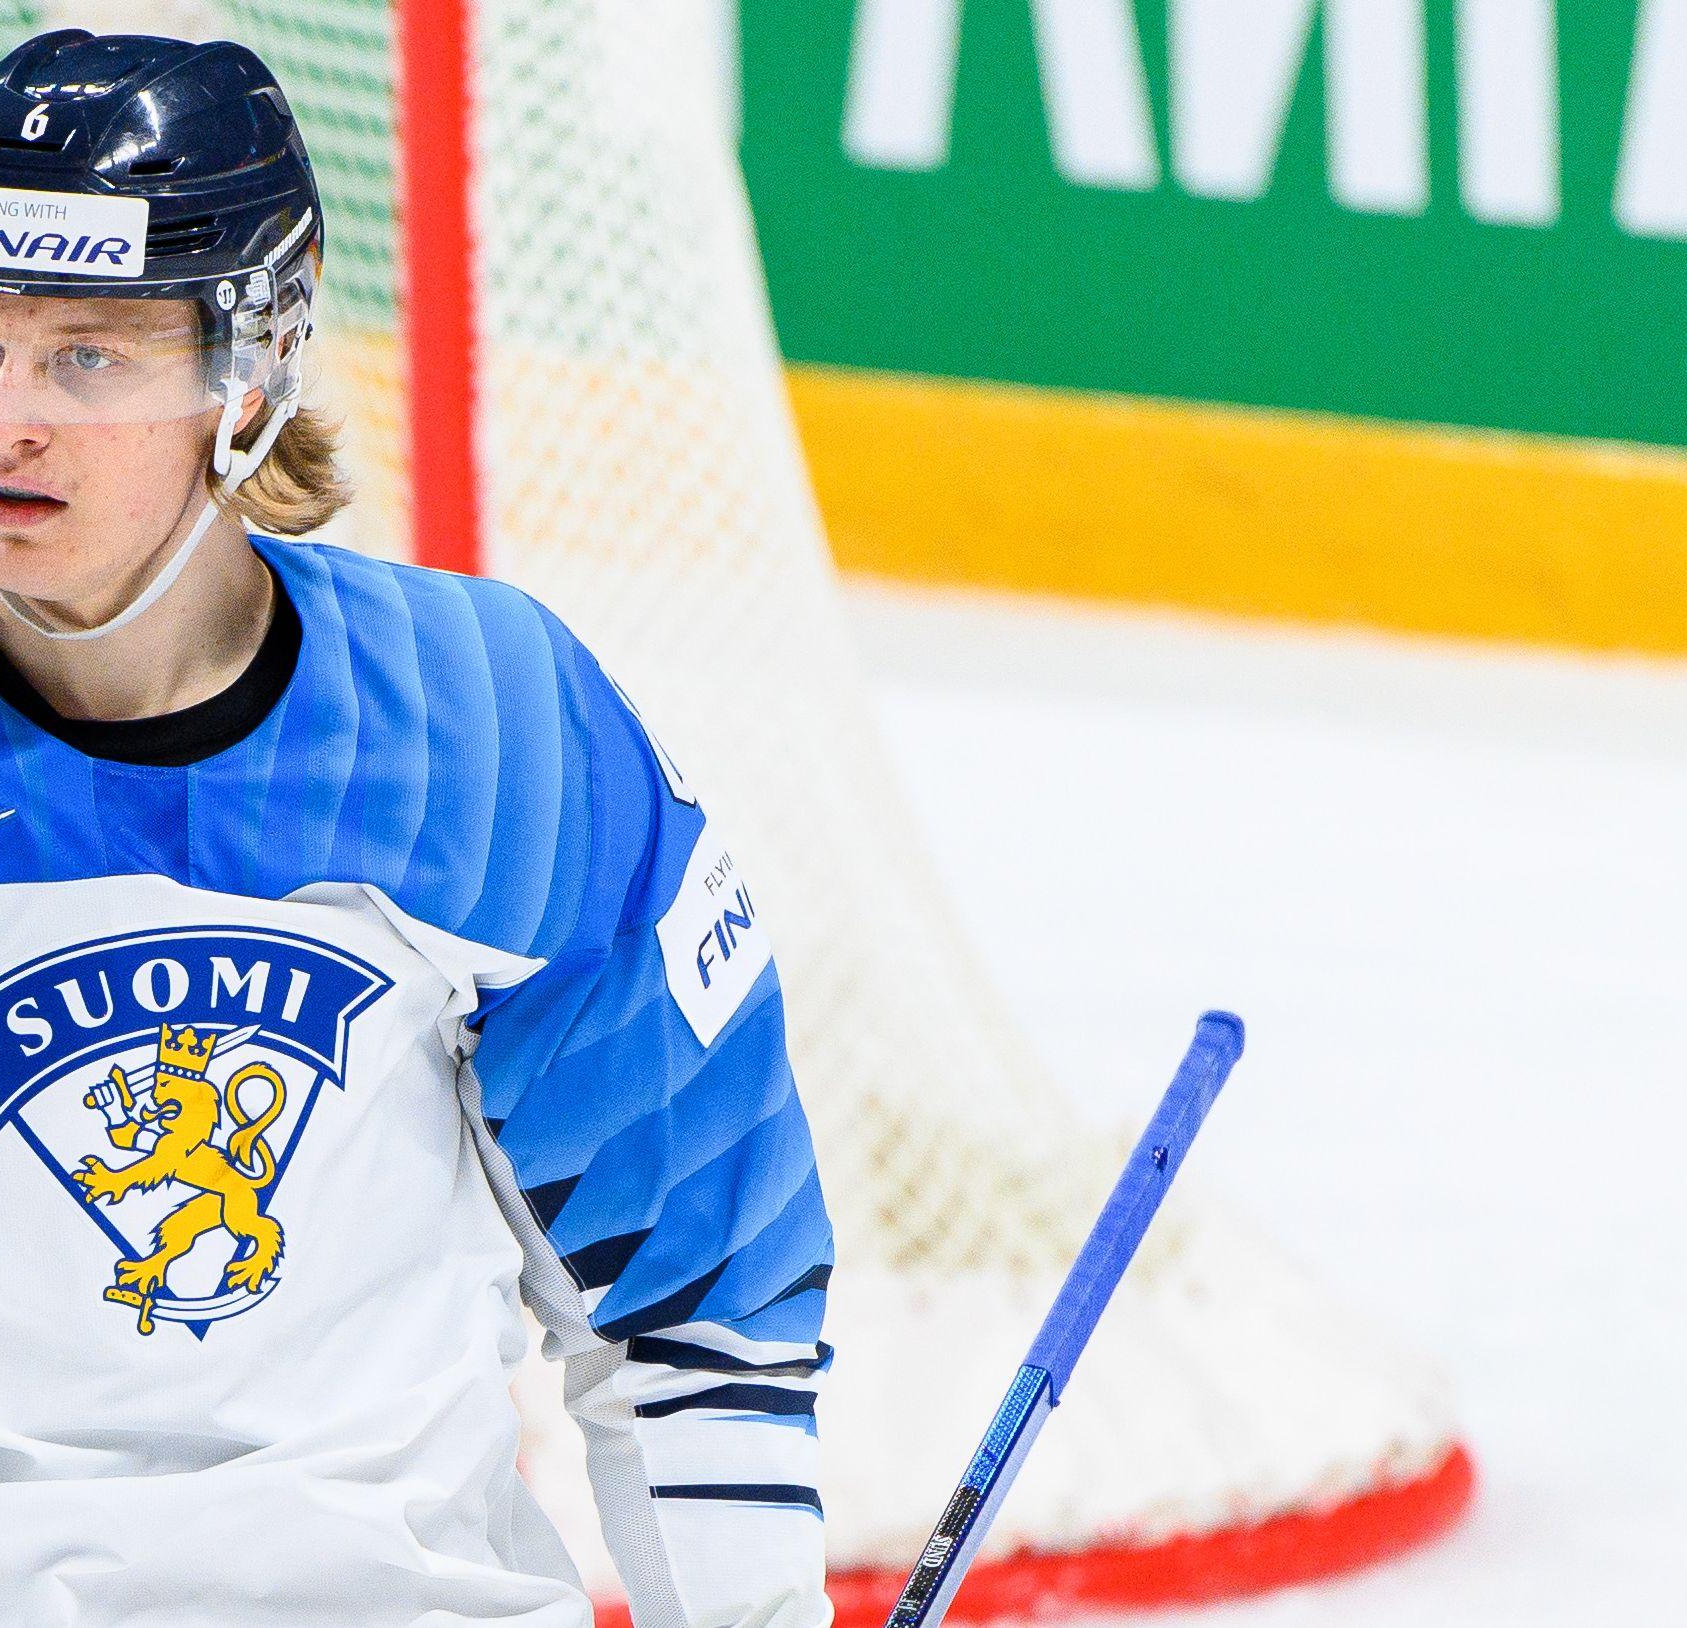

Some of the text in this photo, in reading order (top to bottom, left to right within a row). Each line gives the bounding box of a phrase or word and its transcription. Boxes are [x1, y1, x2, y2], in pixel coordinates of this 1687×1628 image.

[20, 103, 50, 141] 6
[24, 202, 67, 221] WITH
[5, 956, 311, 1057] SUOMI
